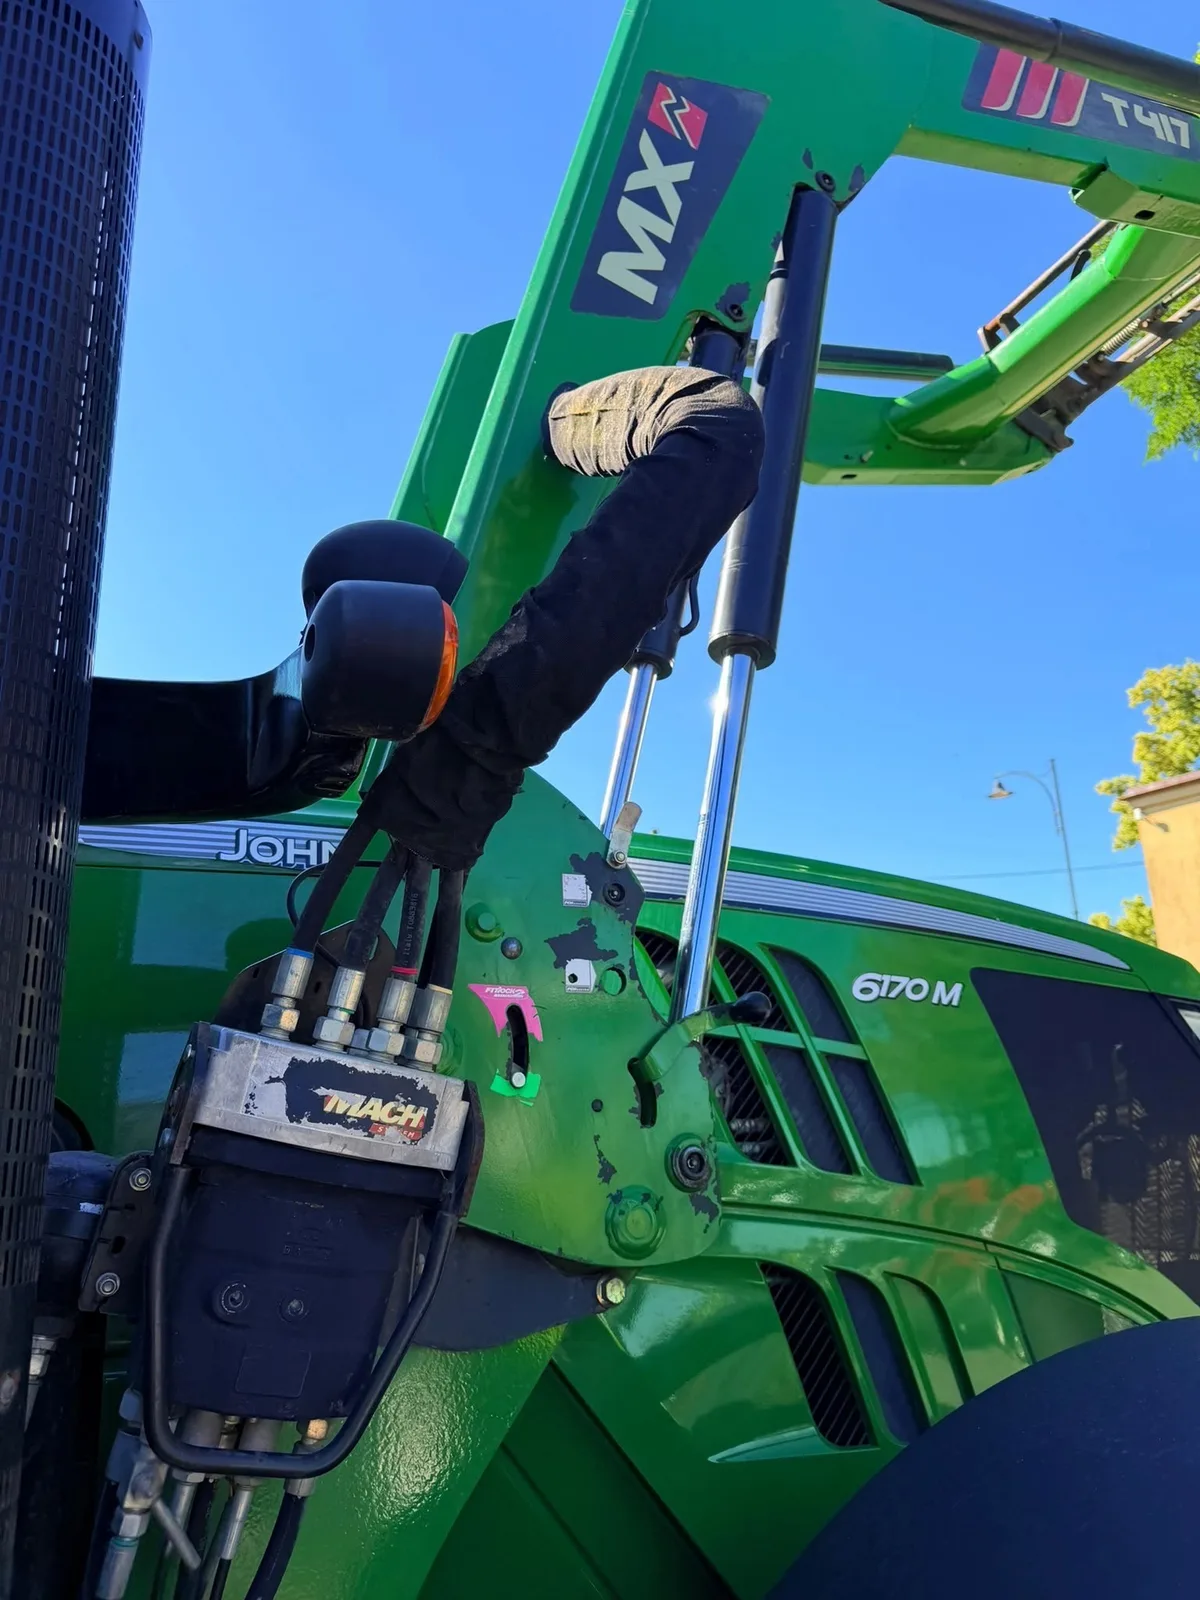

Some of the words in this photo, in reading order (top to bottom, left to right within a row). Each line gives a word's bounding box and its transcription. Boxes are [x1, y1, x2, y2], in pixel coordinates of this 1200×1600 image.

[597, 128, 695, 305] MX
[852, 972, 930, 1002] 6170
[931, 980, 963, 1007] M
[323, 1094, 428, 1129] MACH
